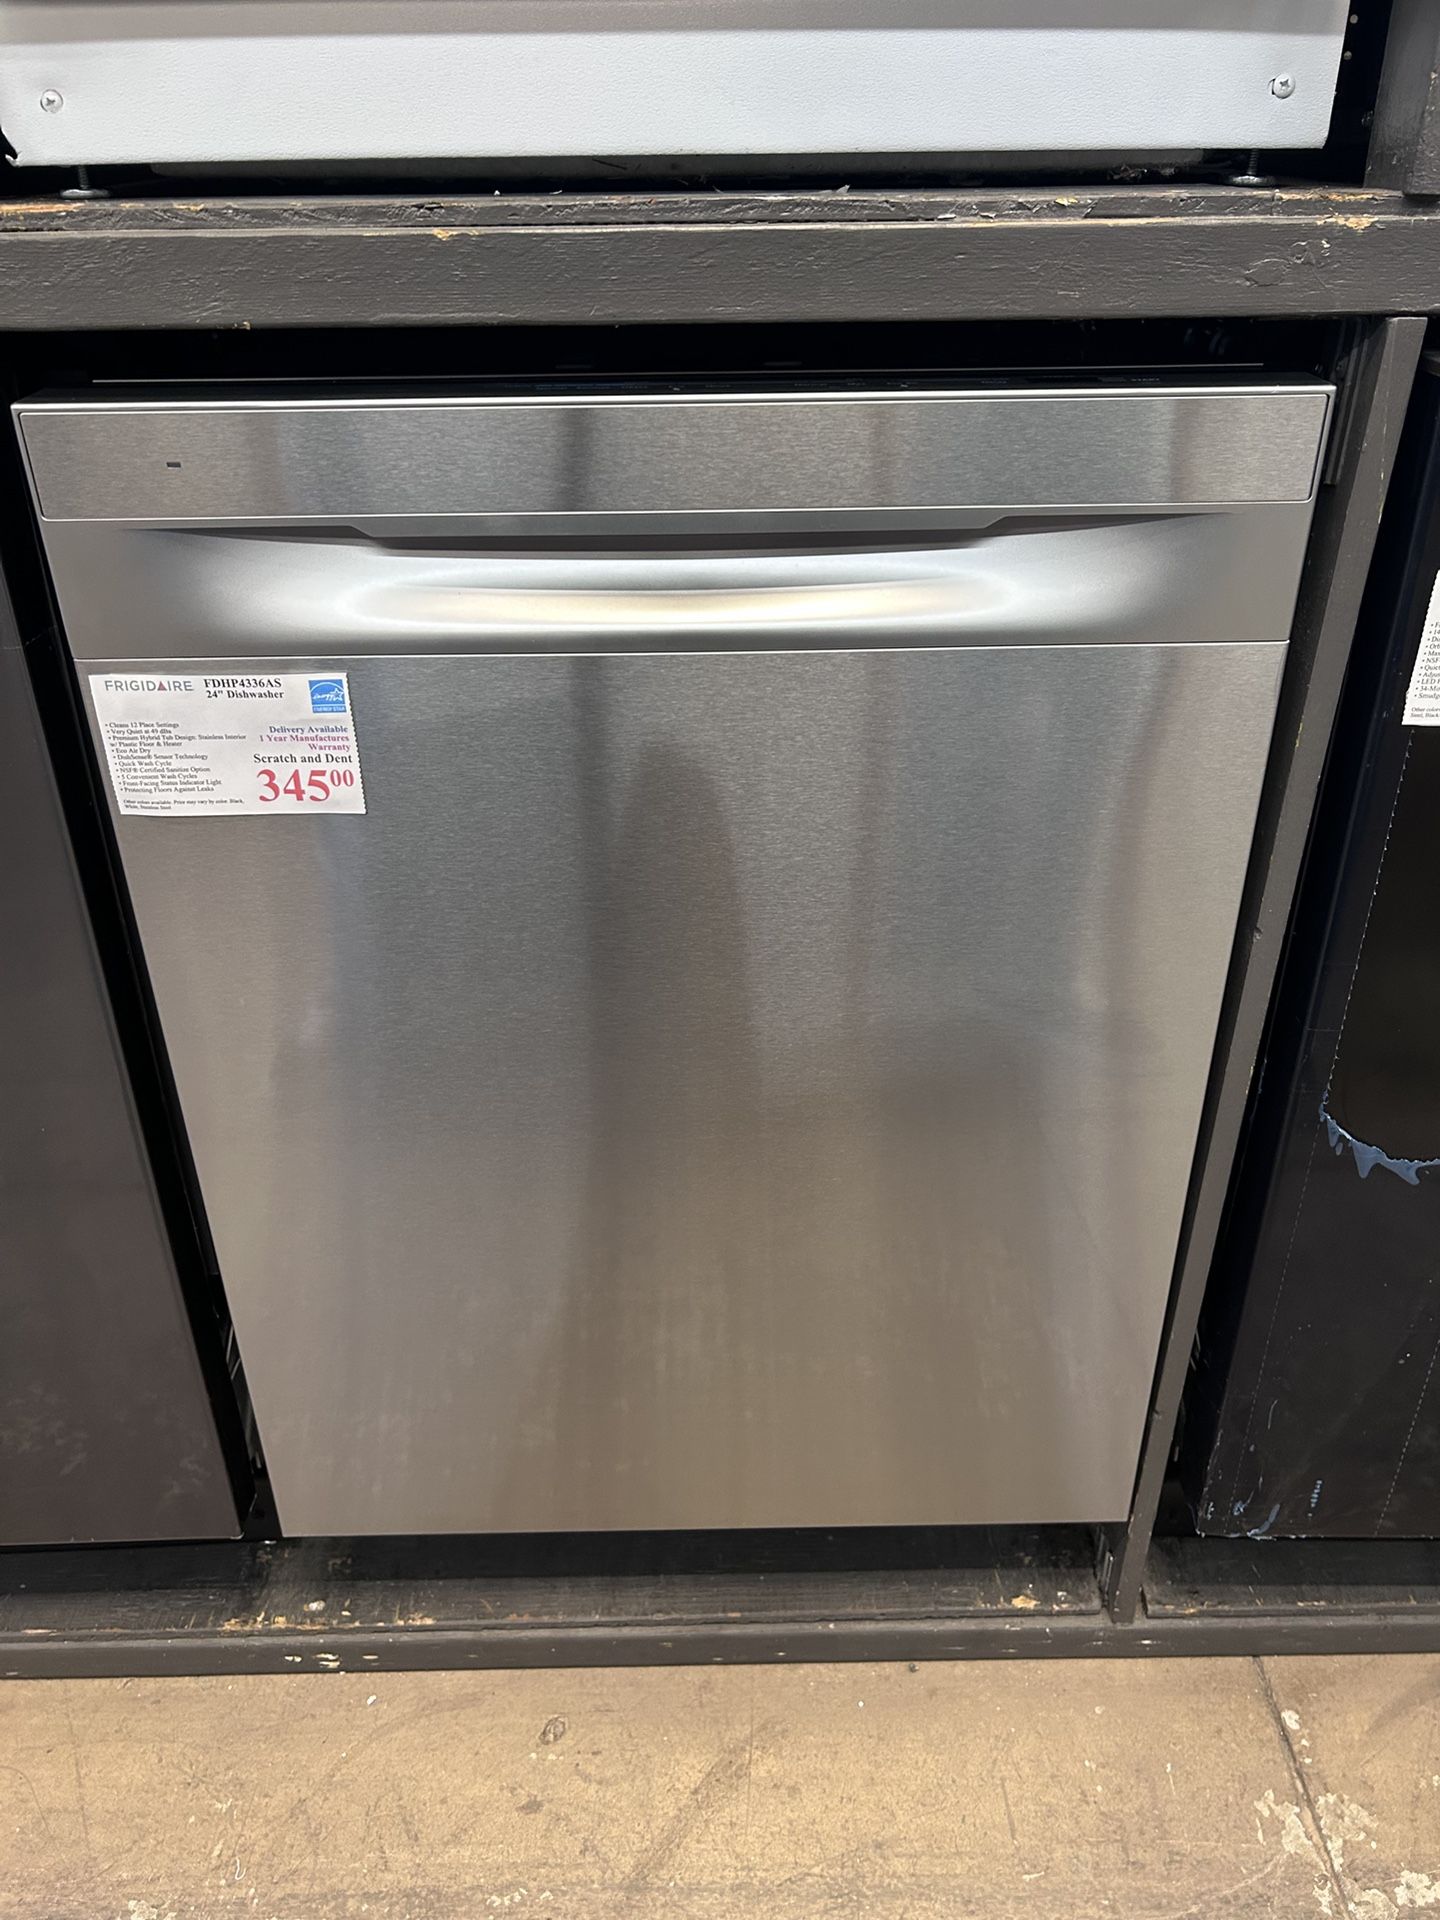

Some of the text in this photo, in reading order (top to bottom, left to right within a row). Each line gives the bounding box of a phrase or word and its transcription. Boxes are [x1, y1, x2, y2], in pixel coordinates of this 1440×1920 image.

[105, 680, 194, 691] FRIGIDAIRE
[203, 679, 282, 689] FDHP4336AS
[207, 690, 285, 699] 24" Dishwasher
[269, 725, 348, 735] Delivery Available
[266, 734, 287, 742] Year
[289, 733, 350, 742] Manufactures
[139, 748, 151, 756] Dry
[308, 743, 351, 752] Warranty
[175, 753, 208, 761] Technology
[253, 753, 352, 764] Scratch and Dent
[124, 786, 153, 794] Protecting
